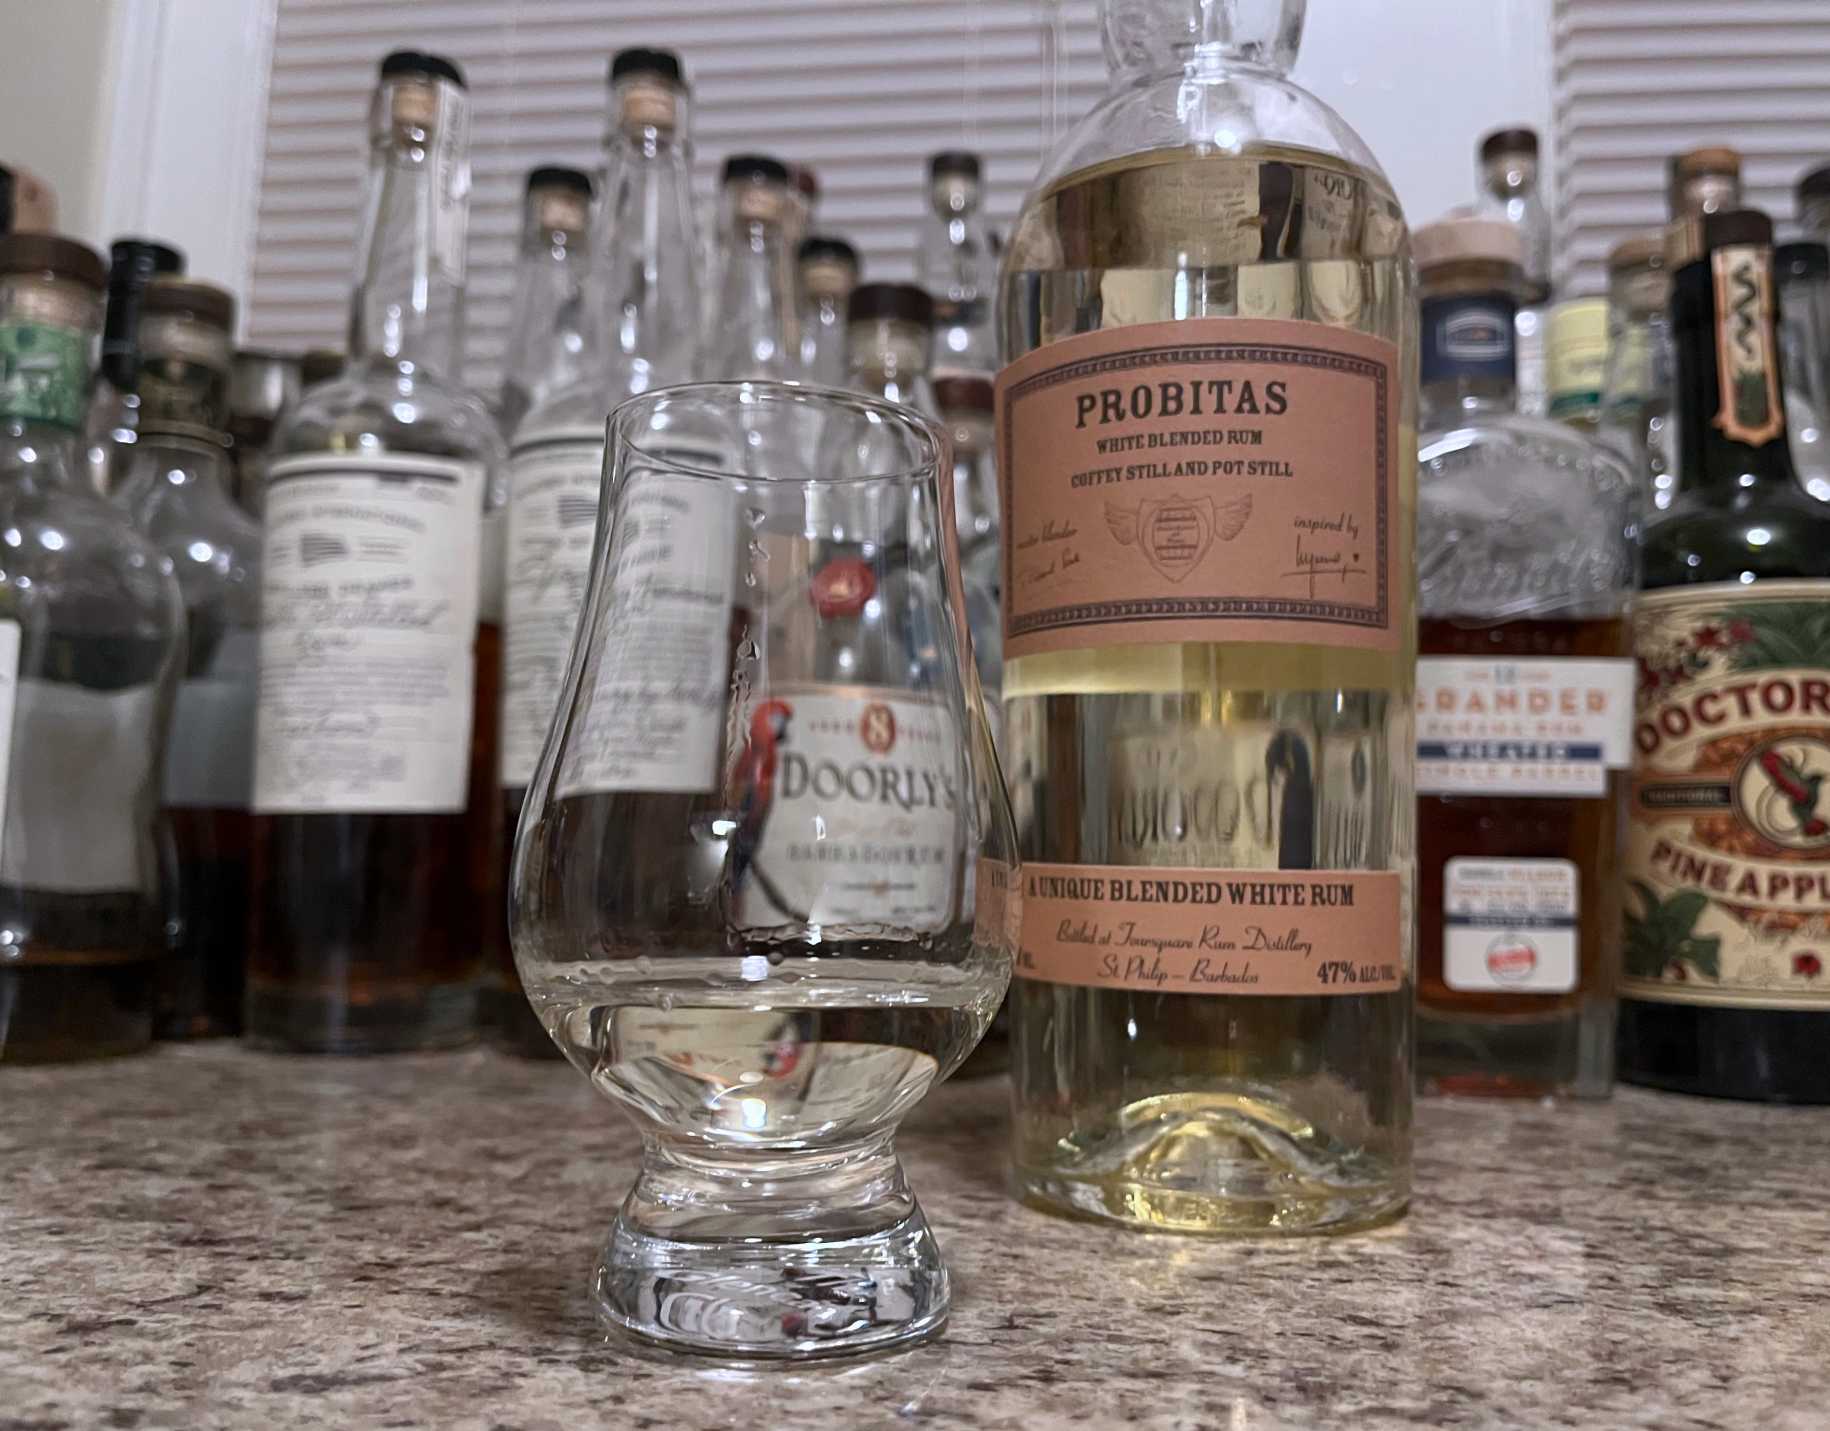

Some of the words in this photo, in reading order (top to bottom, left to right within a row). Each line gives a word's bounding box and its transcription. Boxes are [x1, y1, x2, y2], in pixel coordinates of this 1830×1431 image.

[1075, 380, 1288, 429] PROBITAS
[1096, 434, 1145, 455] WHITE
[1147, 430, 1224, 449] BLENDED
[1227, 429, 1263, 446] RUM
[1071, 464, 1123, 488] COFFEY
[1125, 463, 1172, 480] STILL
[1173, 460, 1209, 479] AND
[1211, 460, 1244, 476] POT
[1247, 460, 1294, 477] STILL
[1293, 511, 1345, 535] inspired
[1346, 513, 1359, 540] by
[1027, 876, 1036, 898] A
[1039, 875, 1105, 901] UNIQUE
[1109, 879, 1223, 905] BLENDED
[1226, 882, 1306, 906] WHITE
[1310, 883, 1355, 907] RUM
[1056, 918, 1099, 945] Bottled
[1198, 924, 1236, 951] Rum
[1242, 925, 1313, 960] Distillery
[1124, 954, 1169, 986] Philip
[1189, 958, 1260, 984] Barbados
[1316, 961, 1357, 985] 47%
